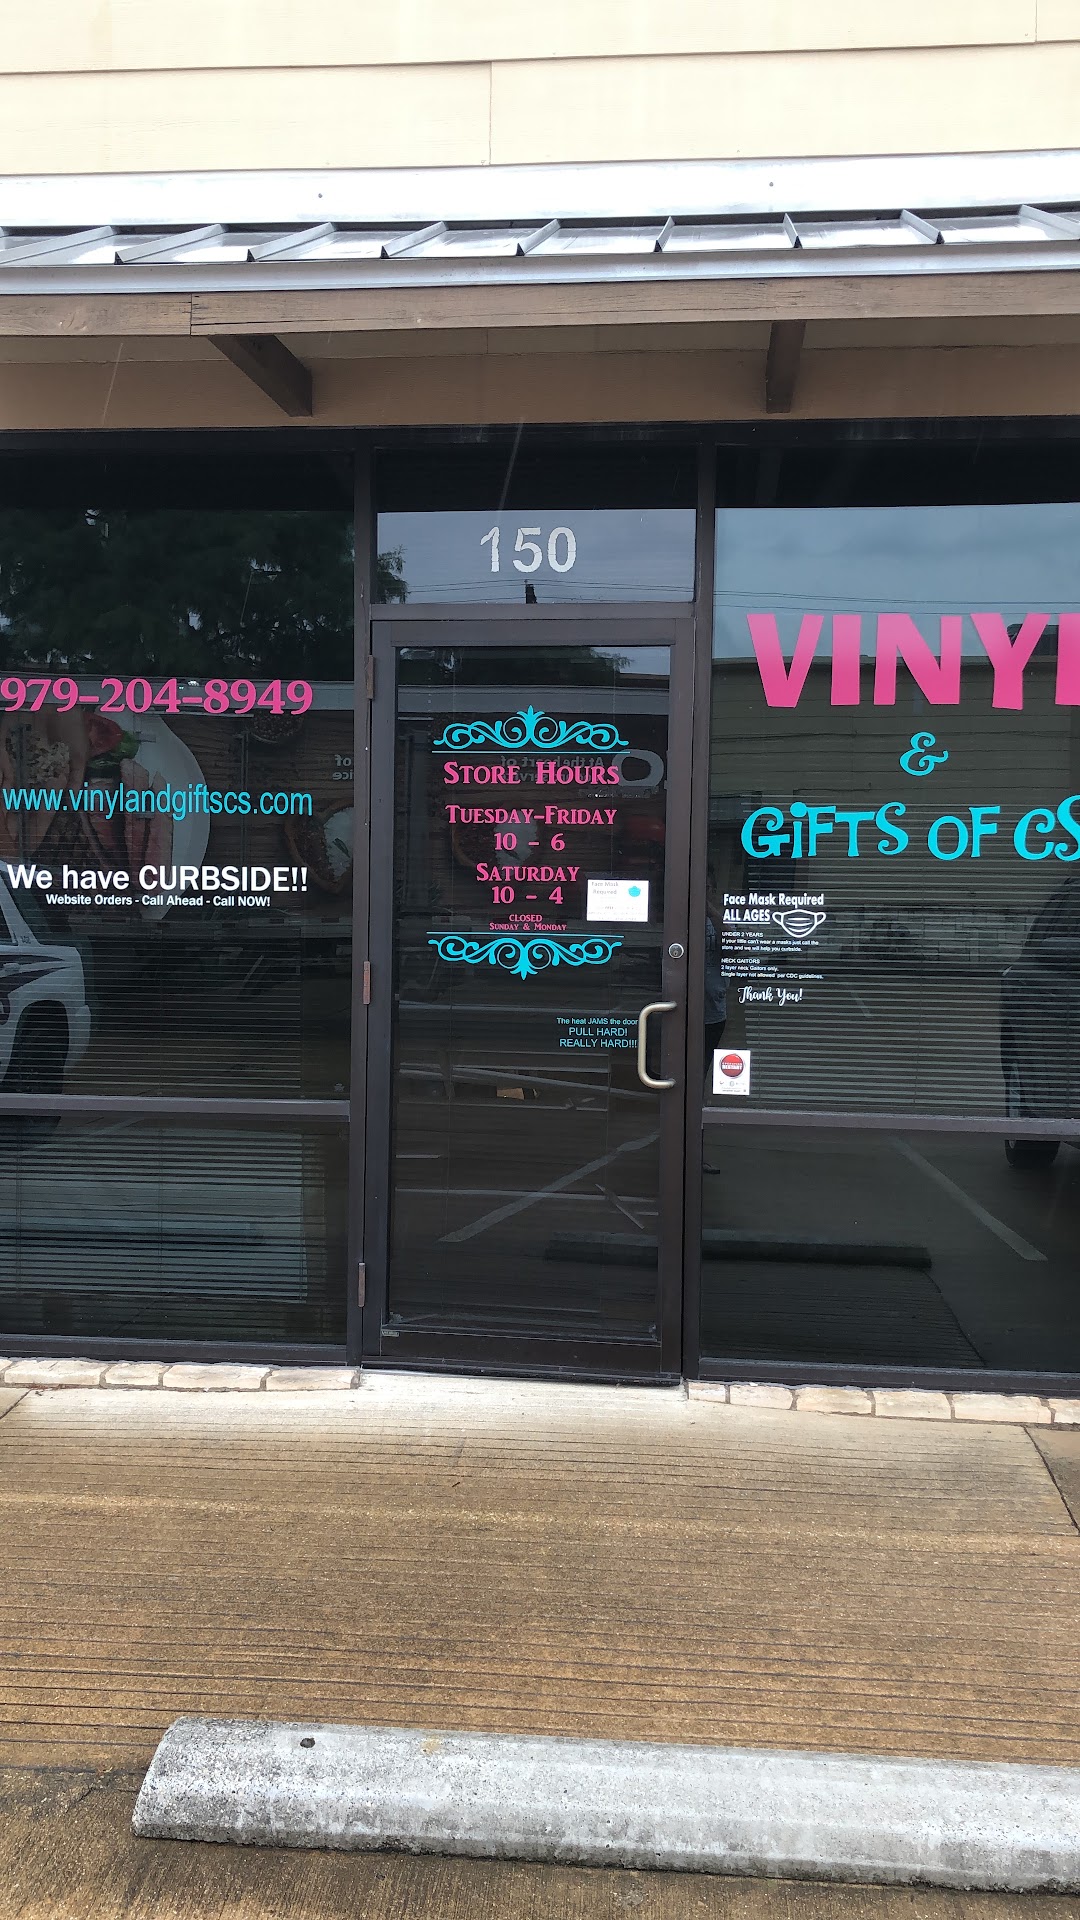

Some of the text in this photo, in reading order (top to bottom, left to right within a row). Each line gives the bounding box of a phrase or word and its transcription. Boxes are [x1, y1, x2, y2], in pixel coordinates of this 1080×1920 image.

[480, 526, 577, 573] 150
[1, 677, 313, 715] 979-204-8949
[899, 732, 949, 777] &
[443, 761, 521, 785] STORE
[535, 761, 620, 785] HOURS
[2, 781, 313, 821] www.vinylandgiftscs.com
[445, 804, 618, 825] TUESDAY-FRIDAY
[494, 832, 518, 851] 10
[550, 833, 566, 851] 6
[927, 805, 1001, 861] OF
[6, 864, 308, 892] We have CURBSIDE!!
[476, 862, 580, 882] SATURDAY
[45, 893, 92, 905] Website
[94, 893, 133, 906] Orders
[141, 894, 164, 906] Call
[166, 894, 204, 906] Ahead
[212, 895, 235, 907] Call
[237, 895, 271, 907] NOW!
[492, 885, 515, 904] 10
[548, 886, 564, 905] 4
[723, 893, 825, 908] Face Mask Required
[508, 914, 543, 923] CLOSED
[723, 908, 771, 922] ALL AGES
[489, 922, 567, 931] SUNDAY & MONDAY
[737, 985, 803, 1006] Thank You!
[556, 1017, 570, 1025] The
[571, 1017, 587, 1025] heat
[587, 1017, 609, 1025] JAMS
[622, 1018, 638, 1026] door
[568, 1027, 628, 1037] PULL HARD!
[559, 1038, 638, 1049] REALLY HARD!!!
